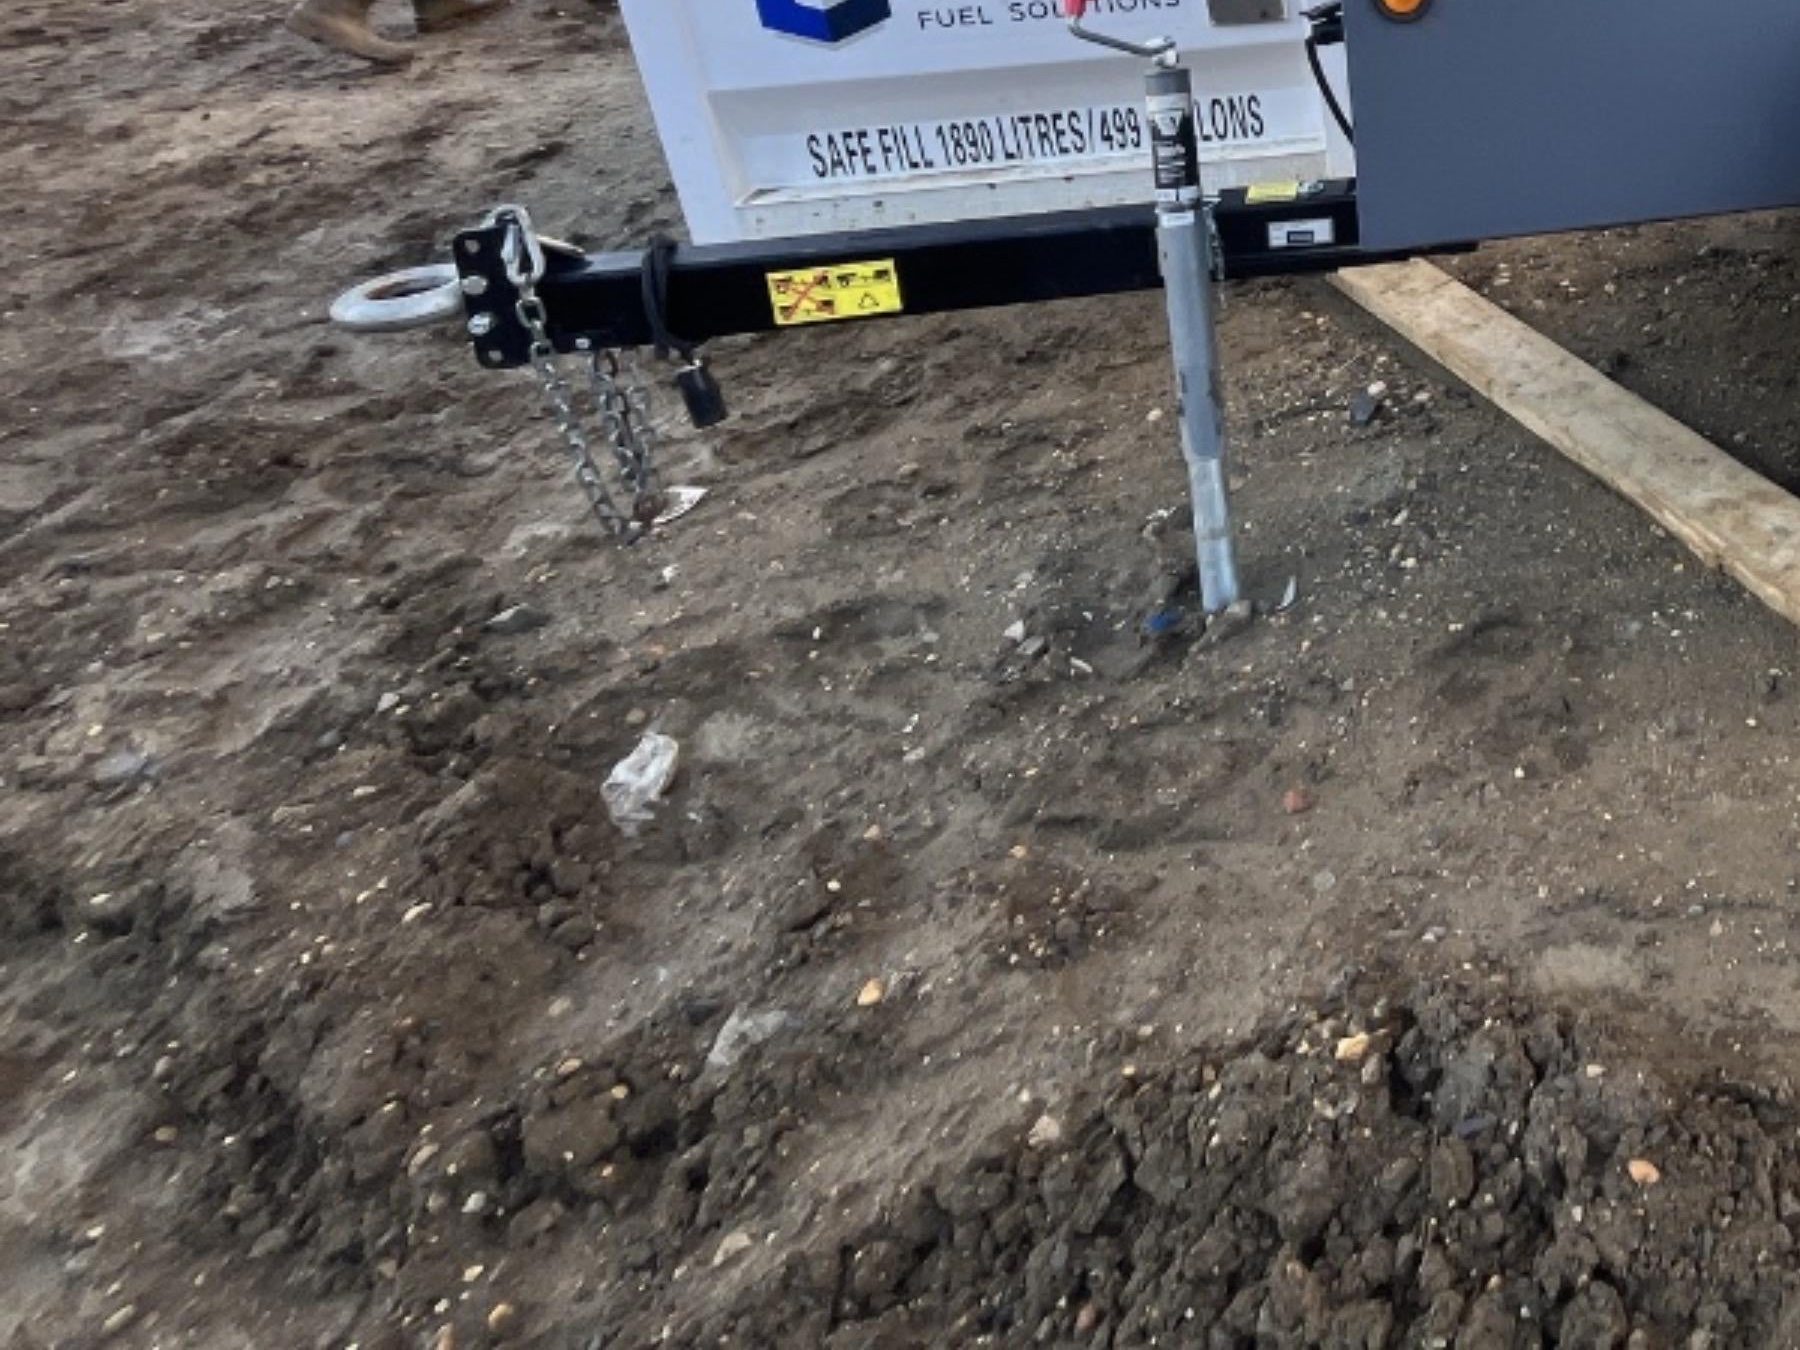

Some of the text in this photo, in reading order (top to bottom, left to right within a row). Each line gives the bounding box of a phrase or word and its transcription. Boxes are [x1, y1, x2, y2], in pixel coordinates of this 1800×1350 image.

[917, 5, 994, 31] FUEL
[806, 128, 877, 178] SAFE
[876, 124, 934, 171] FILL
[935, 119, 994, 166] 1890
